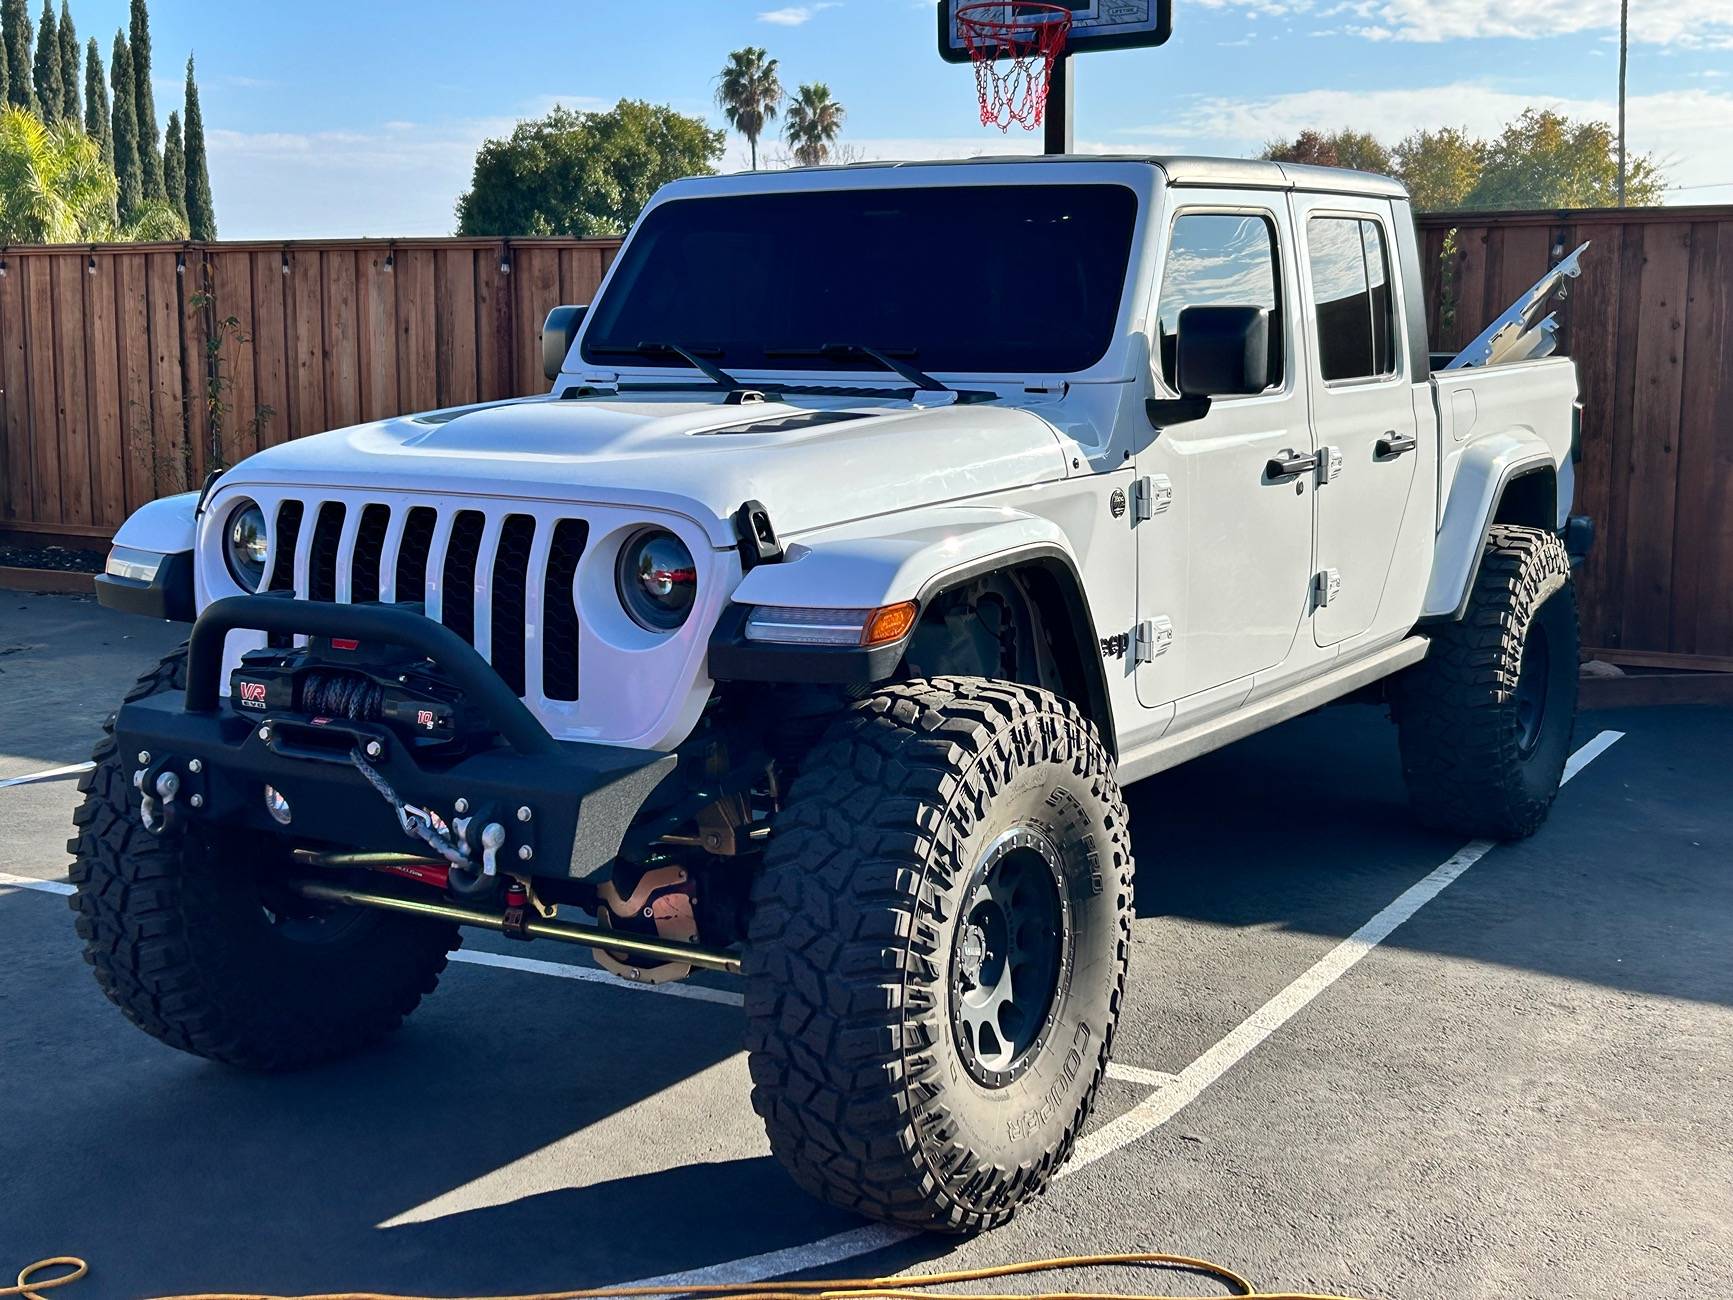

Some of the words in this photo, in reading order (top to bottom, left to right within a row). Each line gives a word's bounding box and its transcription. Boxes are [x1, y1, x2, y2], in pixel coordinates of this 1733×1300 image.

[240, 681, 266, 702] VR
[241, 700, 266, 709] EVO
[1045, 785, 1092, 833] STT
[1080, 832, 1104, 896] PRO
[1006, 1021, 1091, 1144] COOPER
